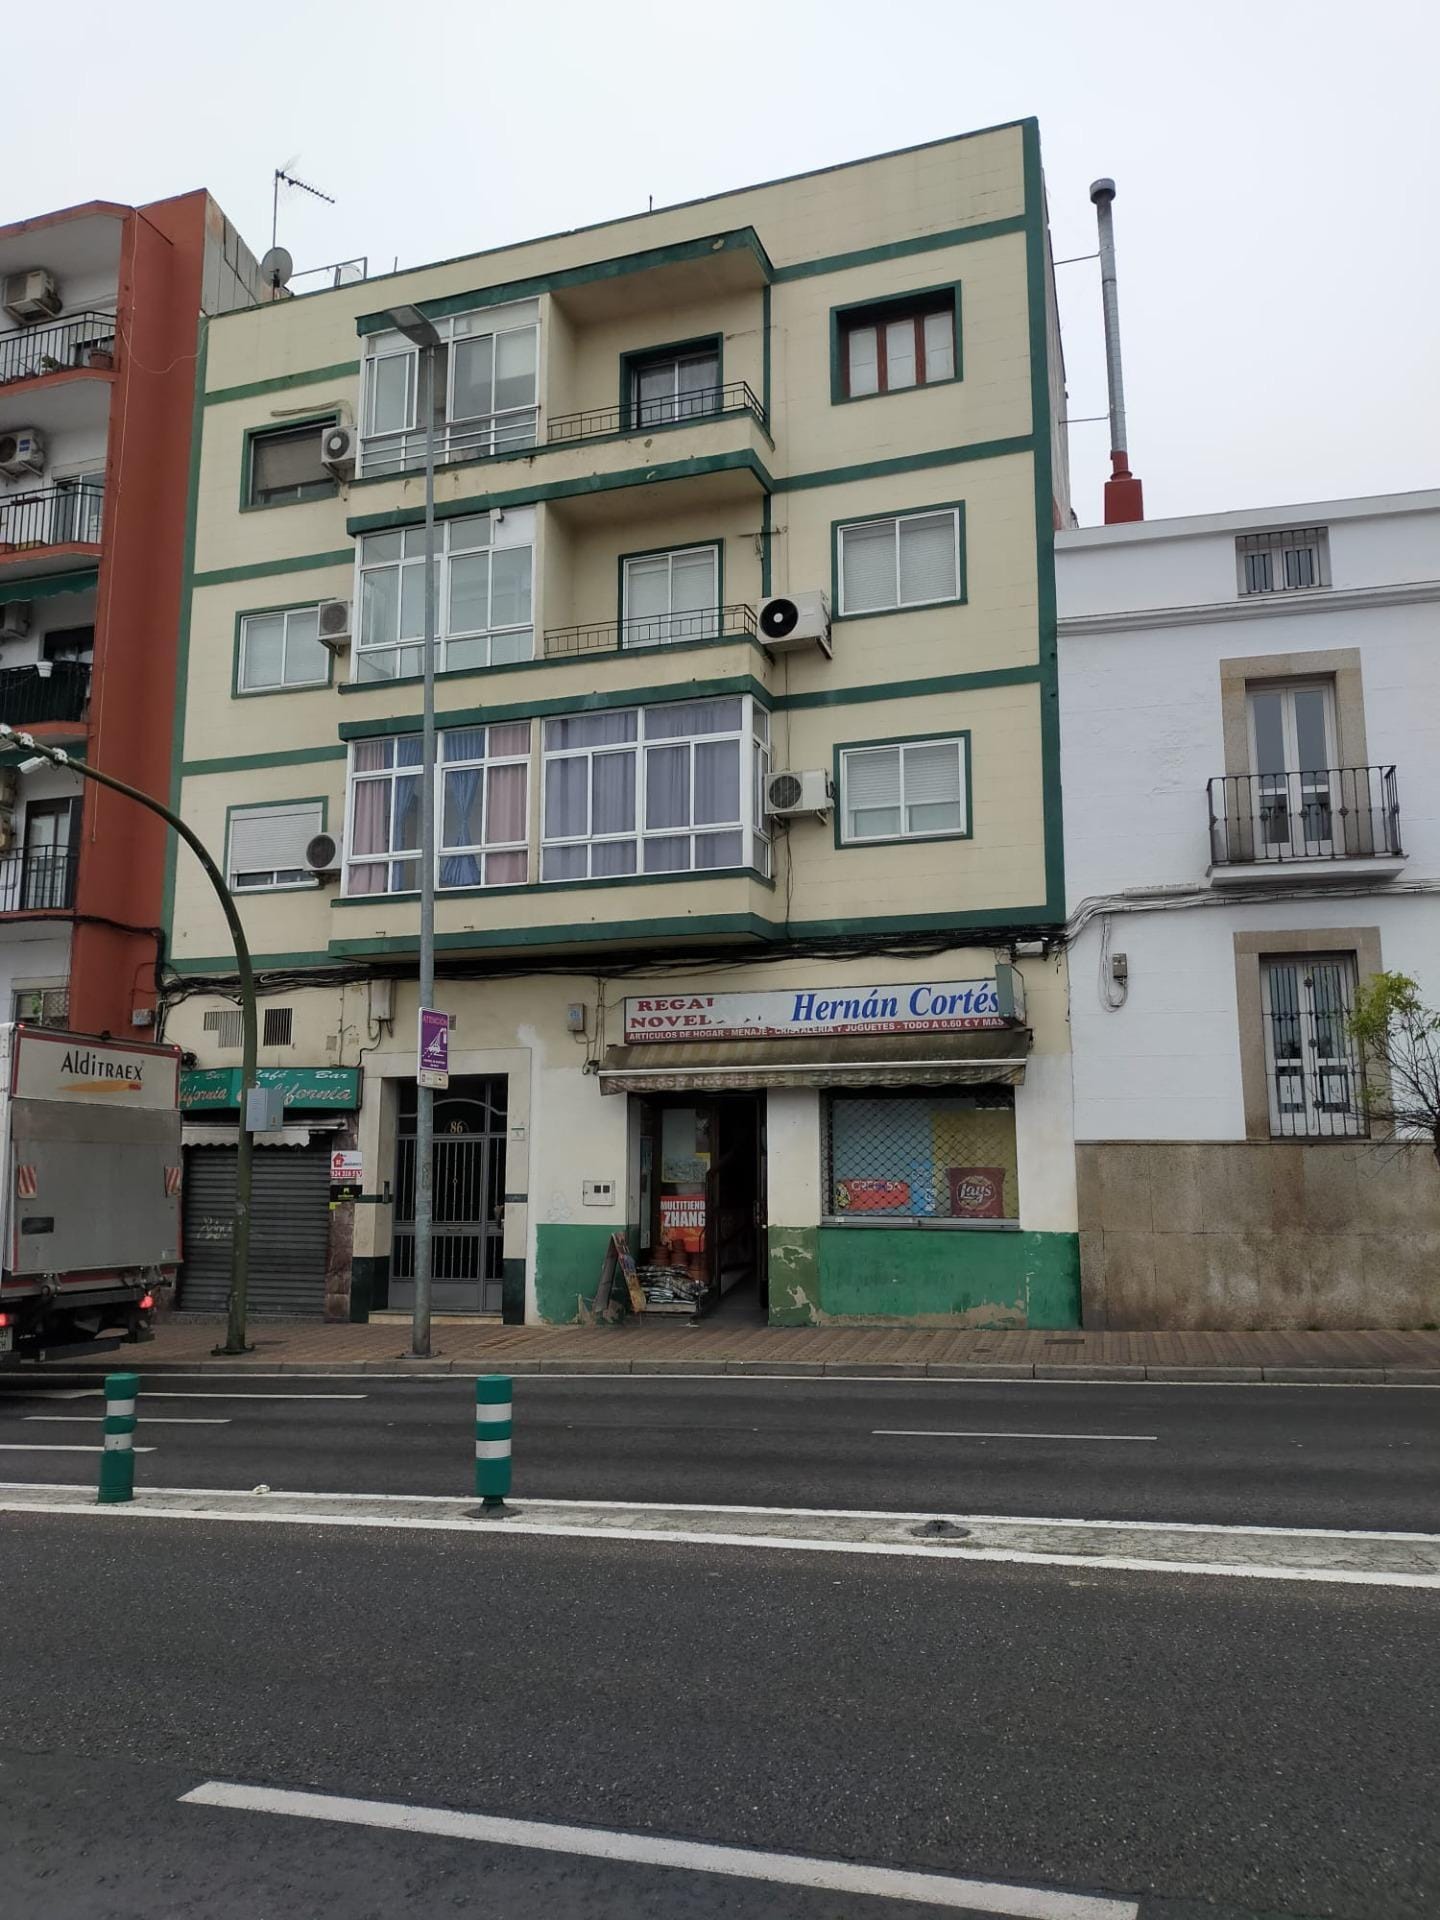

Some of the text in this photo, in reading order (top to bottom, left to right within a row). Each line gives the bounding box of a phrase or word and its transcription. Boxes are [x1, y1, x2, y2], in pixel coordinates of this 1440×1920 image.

[791, 983, 999, 1021] Hernán Cortés
[693, 1029, 724, 1037] HOGAR
[731, 1027, 768, 1036] MENAJE
[845, 1022, 895, 1032] JUGUETES
[904, 1021, 929, 1029] TODO
[932, 1020, 939, 1028] A
[941, 1019, 961, 1028] 0.60
[315, 1070, 349, 1079] Bar
[450, 1120, 463, 1133] 86
[663, 1211, 706, 1227] ZHANG
